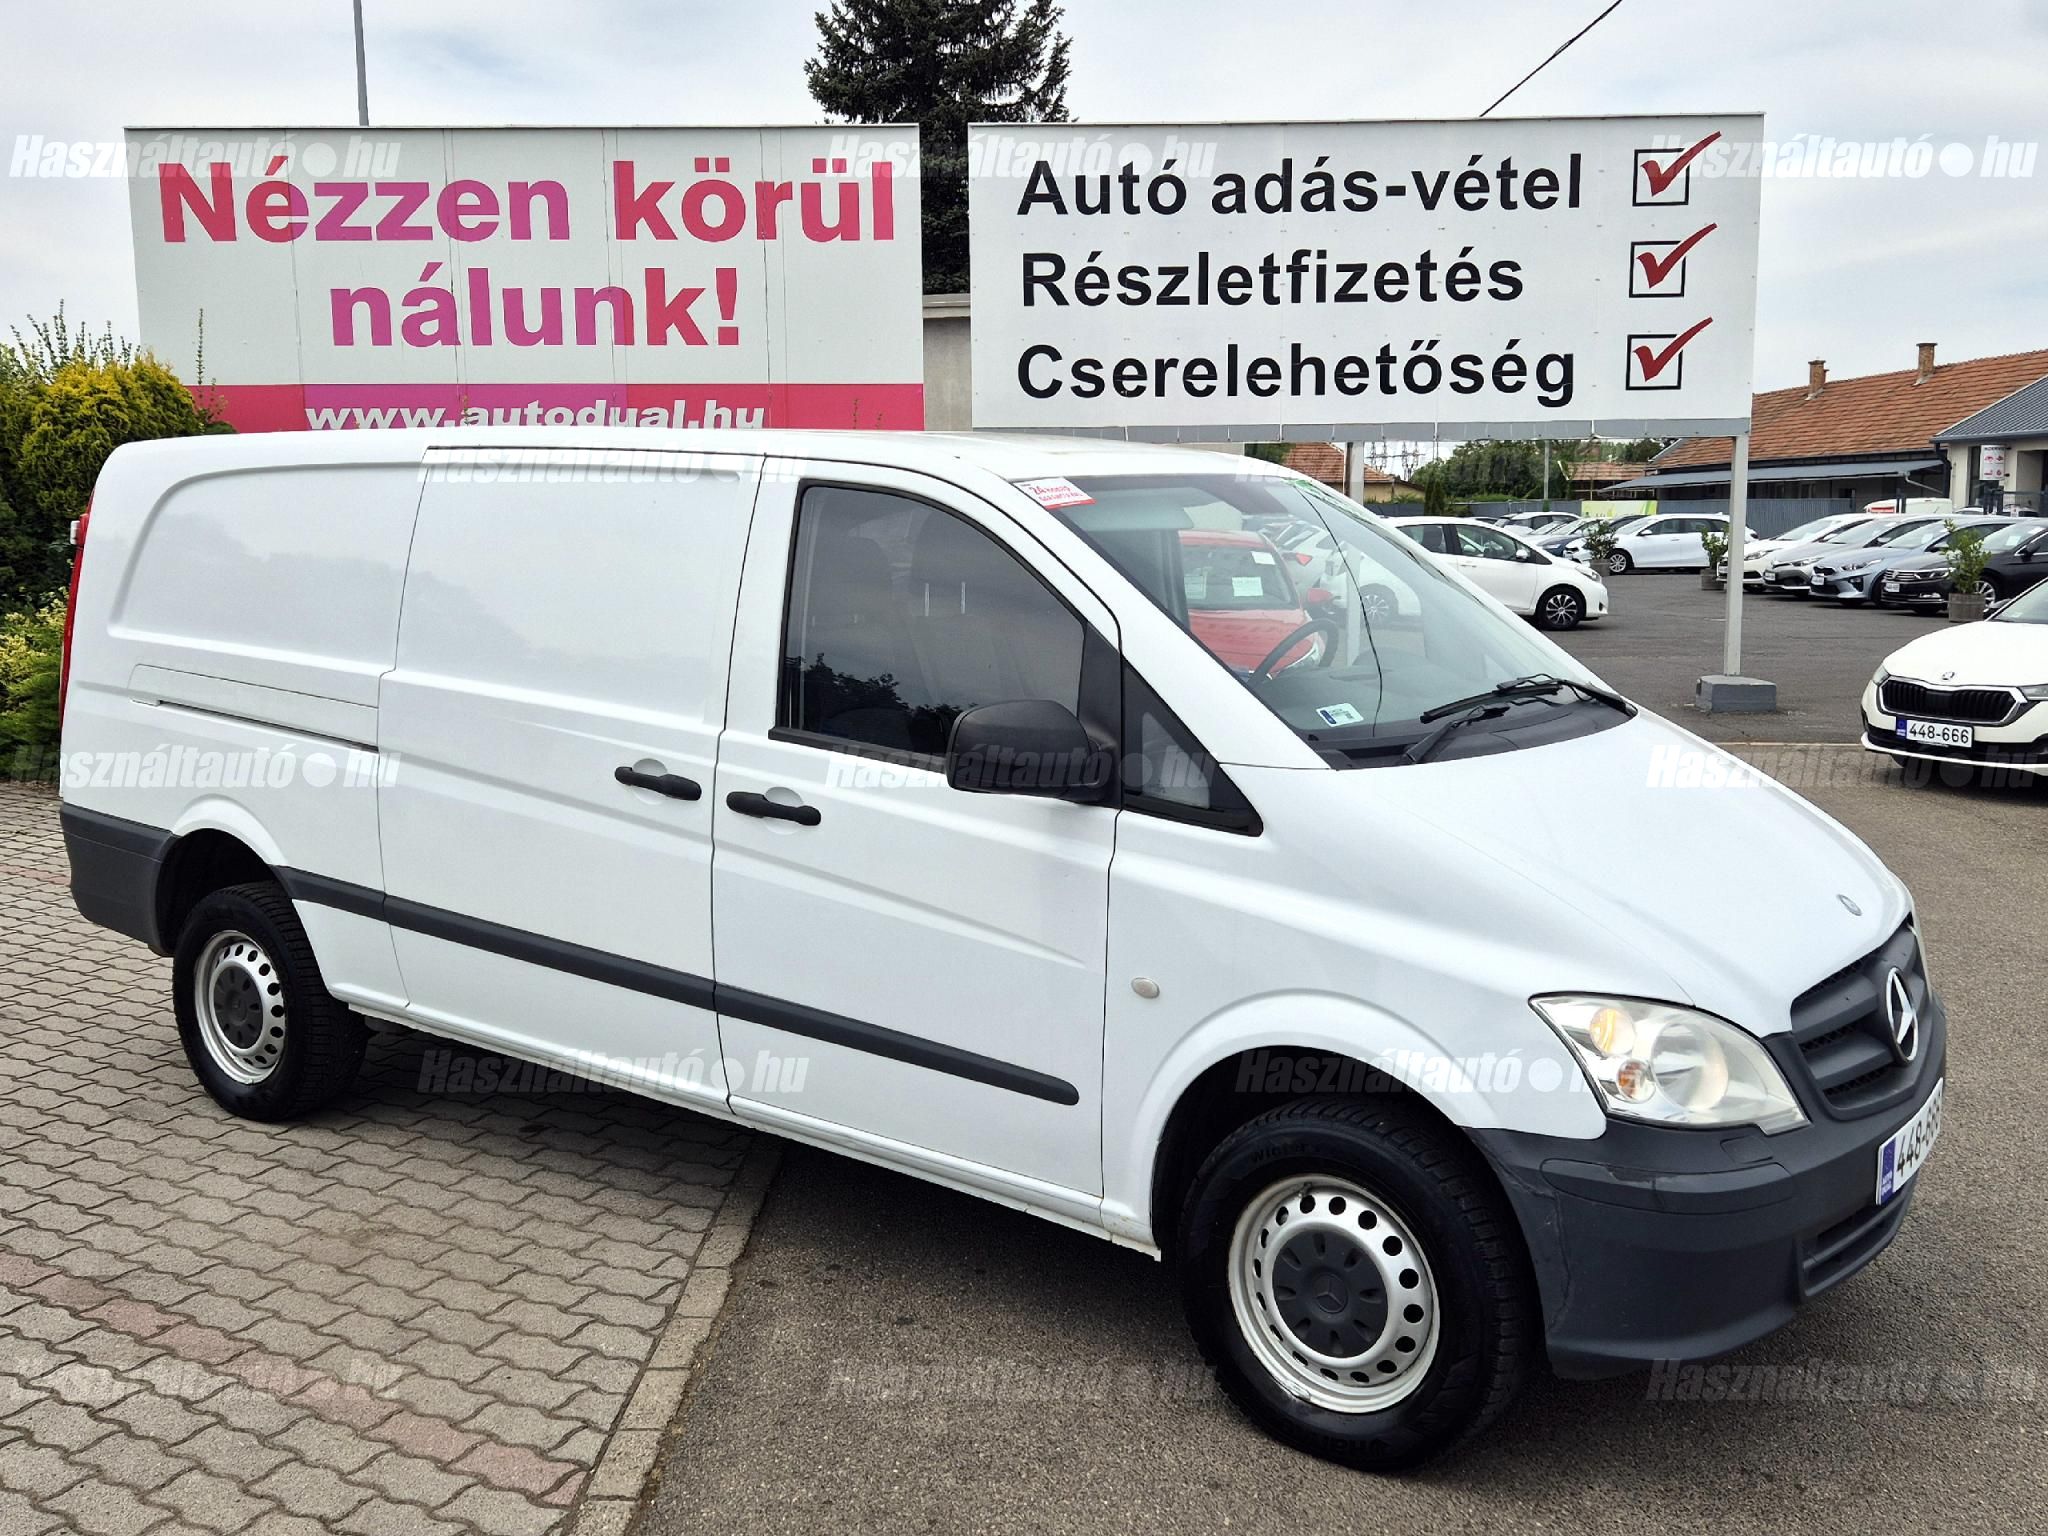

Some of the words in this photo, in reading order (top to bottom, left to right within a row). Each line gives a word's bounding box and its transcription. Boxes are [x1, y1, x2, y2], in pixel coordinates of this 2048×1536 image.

[159, 155, 571, 243] Nézzen
[613, 156, 895, 243] körül
[1016, 158, 1188, 216] Autó
[1211, 153, 1583, 215] adás-vétel
[329, 261, 742, 347] nálunk!
[1022, 246, 1524, 307] Részletfizetés
[1017, 338, 1575, 408] Cserelehetőség
[304, 399, 766, 430] www.autodual.hu
[1908, 723, 1970, 745] 448-666
